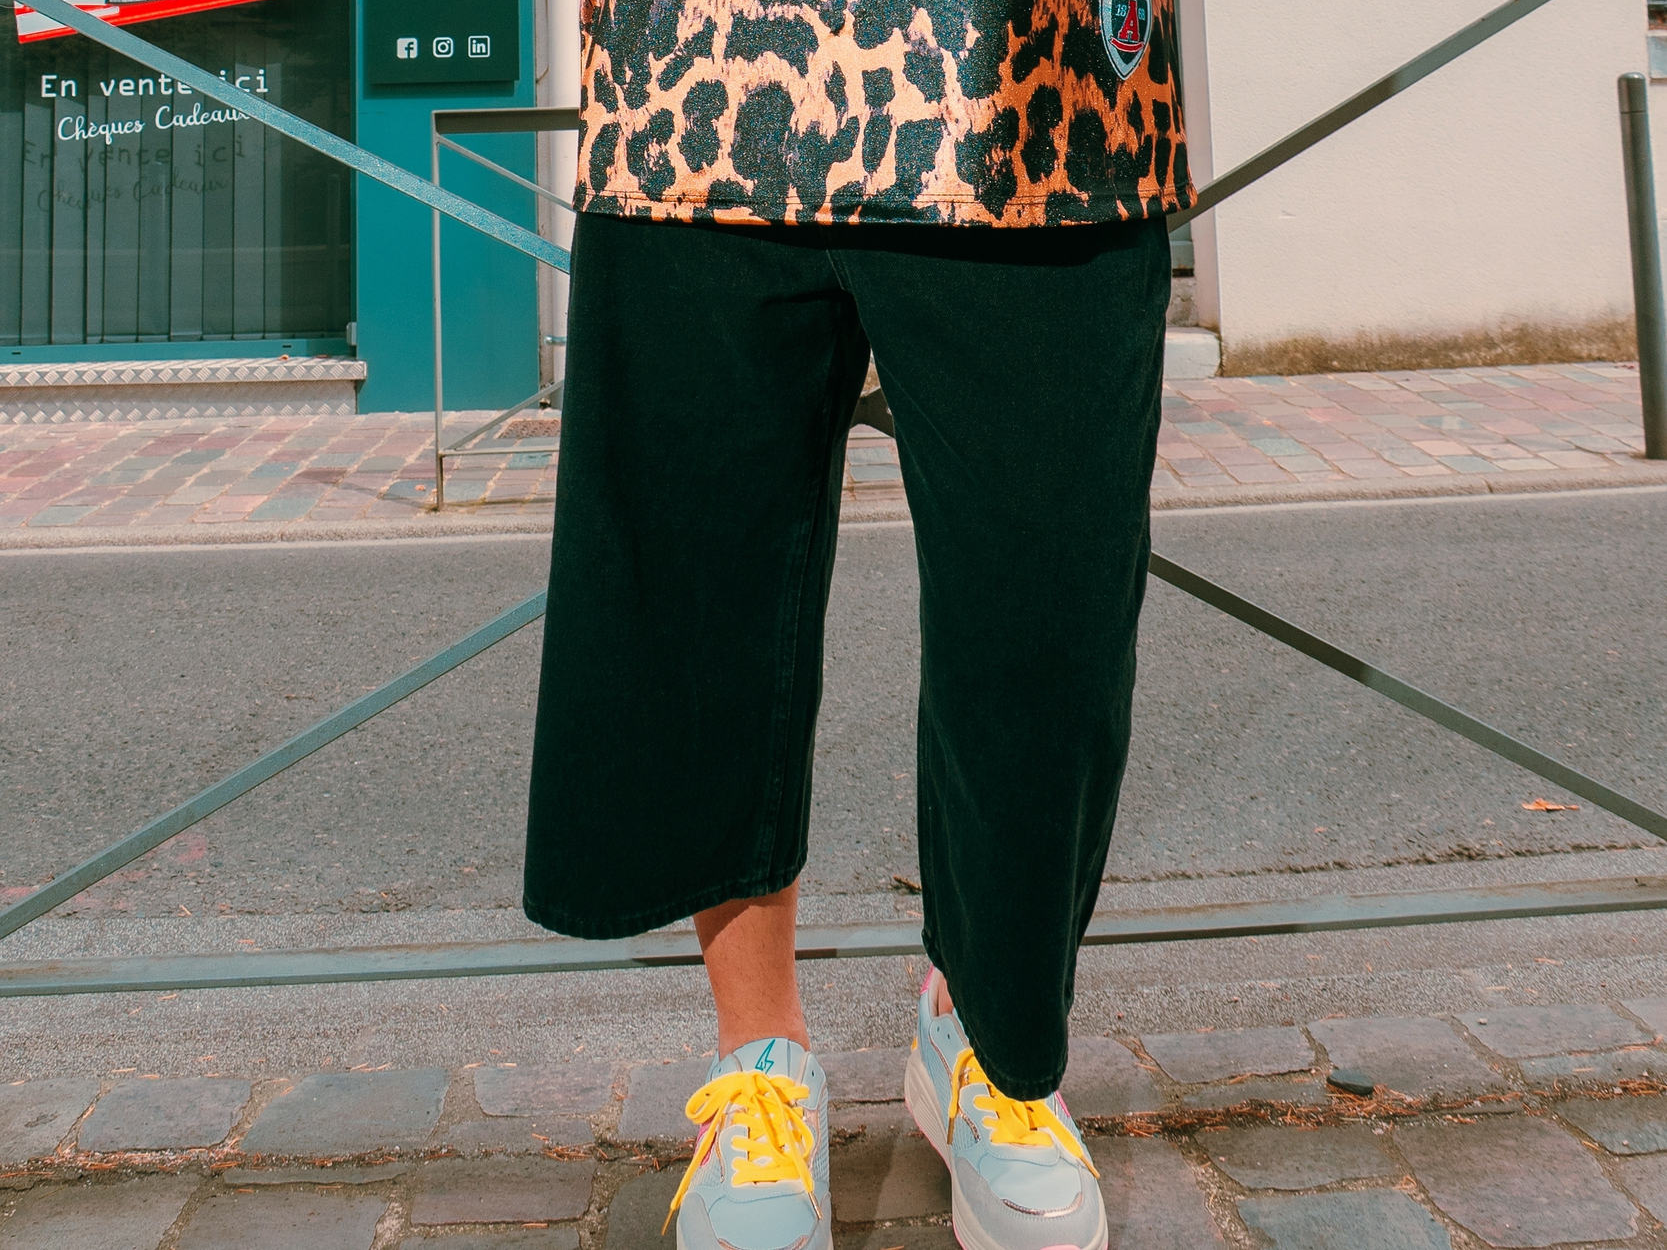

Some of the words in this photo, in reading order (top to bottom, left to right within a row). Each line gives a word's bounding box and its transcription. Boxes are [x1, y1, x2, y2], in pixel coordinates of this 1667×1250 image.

[41, 74, 78, 98] En
[100, 73, 193, 96] vente
[57, 115, 146, 145] Chèques
